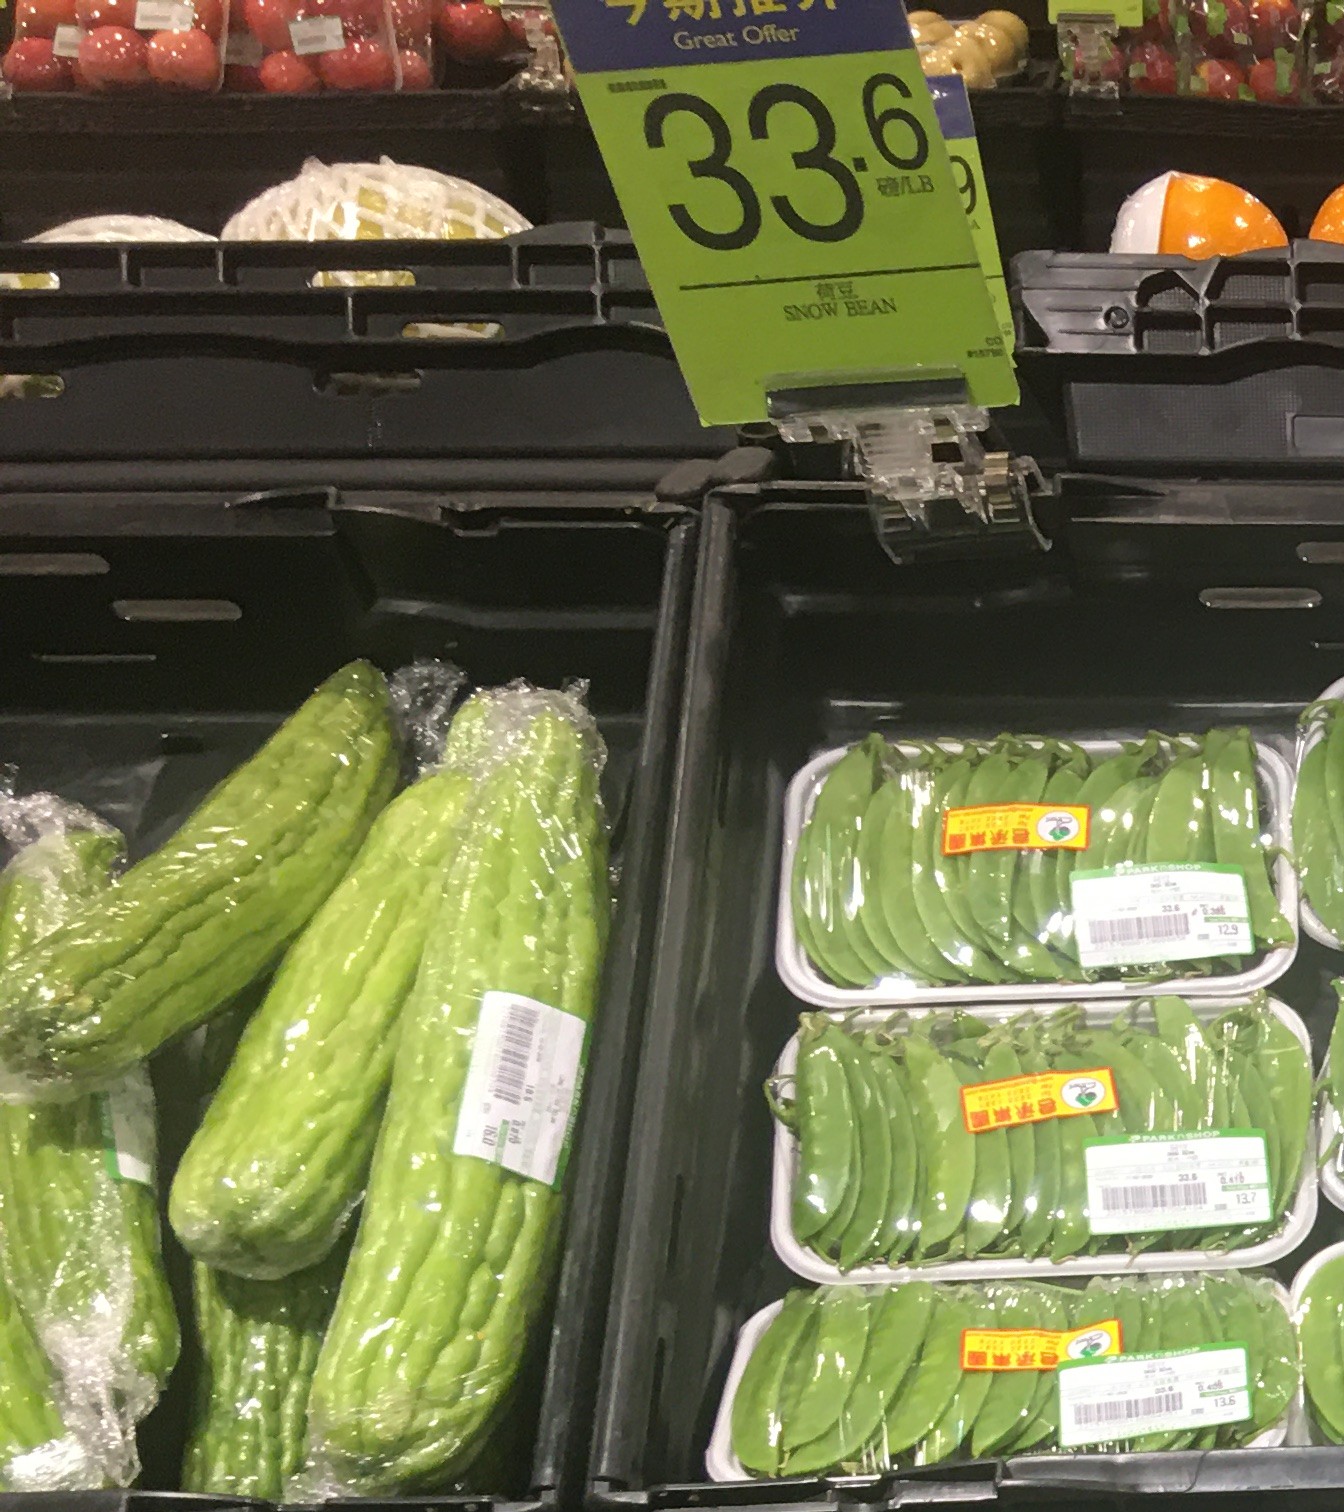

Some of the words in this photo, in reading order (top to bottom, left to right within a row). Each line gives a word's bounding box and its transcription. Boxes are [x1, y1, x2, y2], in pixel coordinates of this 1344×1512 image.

[673, 30, 738, 50] Great
[742, 24, 800, 45] Offer
[643, 73, 929, 251] 33.6
[783, 302, 839, 321] SNOW
[847, 297, 898, 317] BEAN
